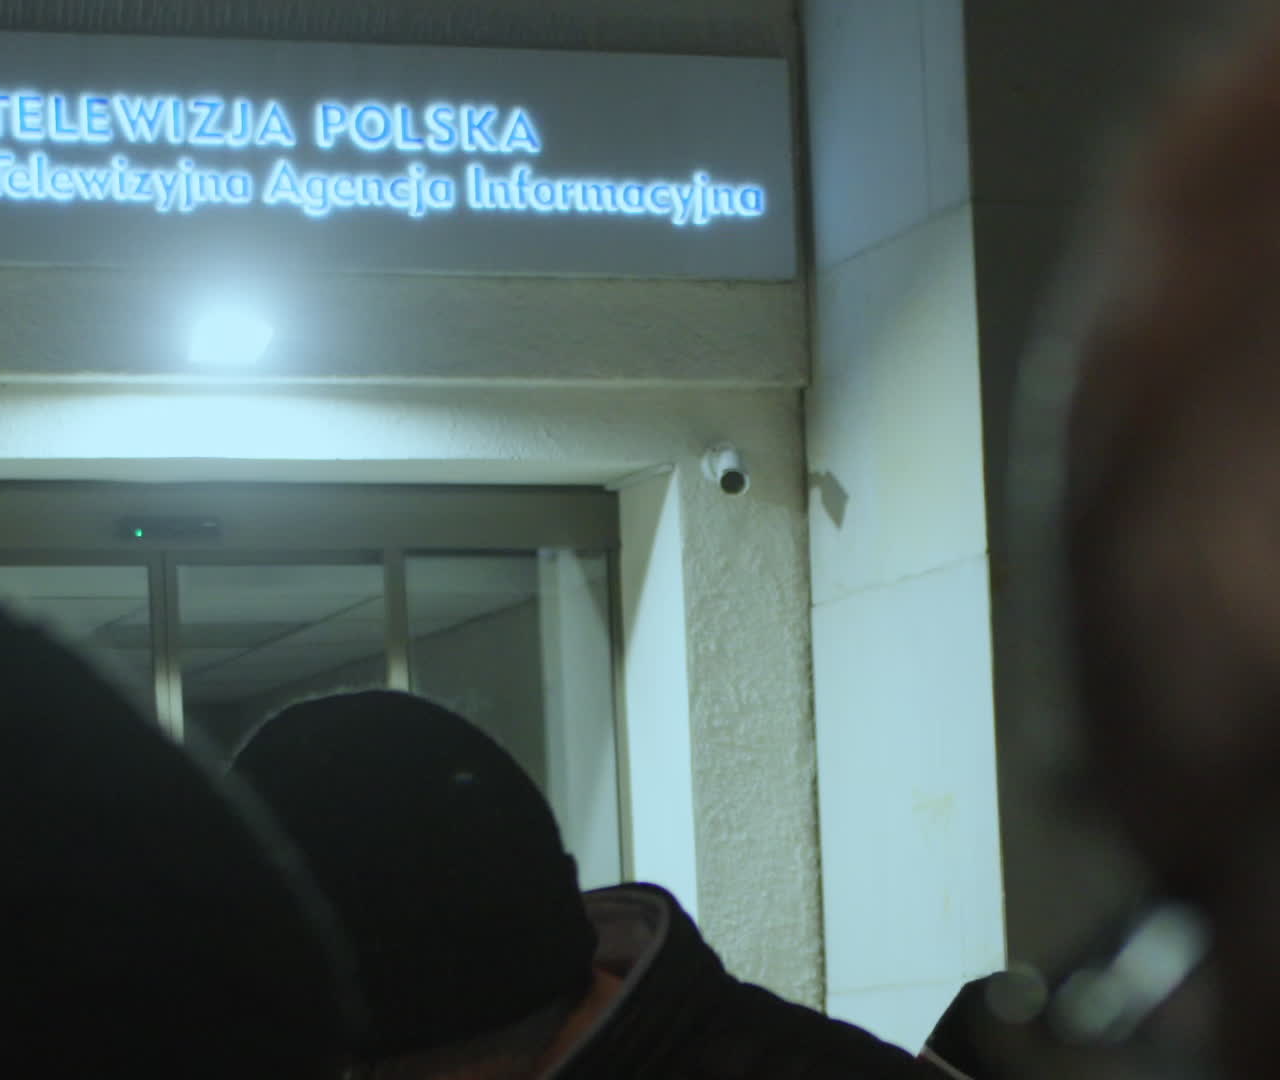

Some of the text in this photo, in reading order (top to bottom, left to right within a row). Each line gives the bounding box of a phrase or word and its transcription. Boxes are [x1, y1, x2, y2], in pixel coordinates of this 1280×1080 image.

[316, 100, 542, 156] POLSKA
[264, 159, 456, 218] Agencja
[466, 162, 766, 226] Informacyjna
